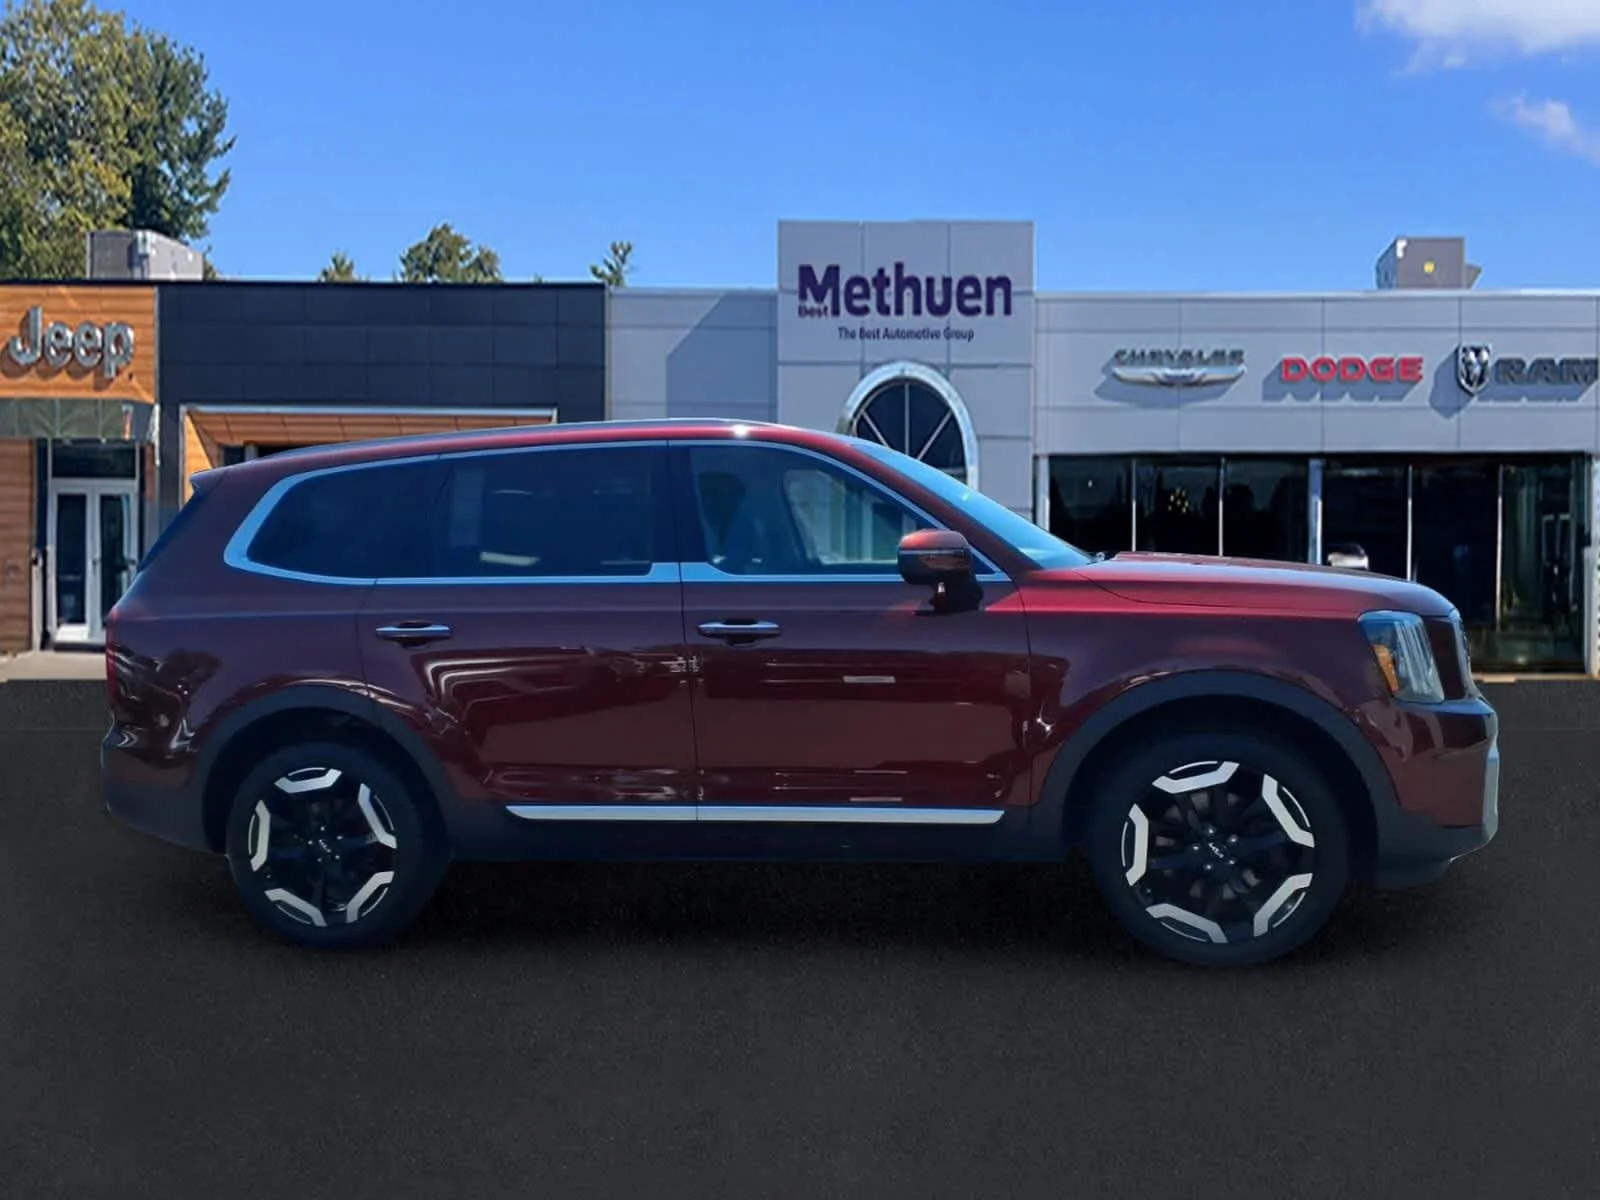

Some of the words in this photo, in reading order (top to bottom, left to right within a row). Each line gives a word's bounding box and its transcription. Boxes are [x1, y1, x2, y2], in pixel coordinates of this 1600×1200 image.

[799, 262, 1012, 317] Methuen
[9, 305, 135, 379] Jeep
[838, 327, 857, 339] The
[859, 327, 880, 339] Best
[882, 327, 941, 340] Automotive
[943, 326, 974, 342] Group
[1282, 357, 1423, 382] DODGE
[1496, 357, 1599, 385] RAM
